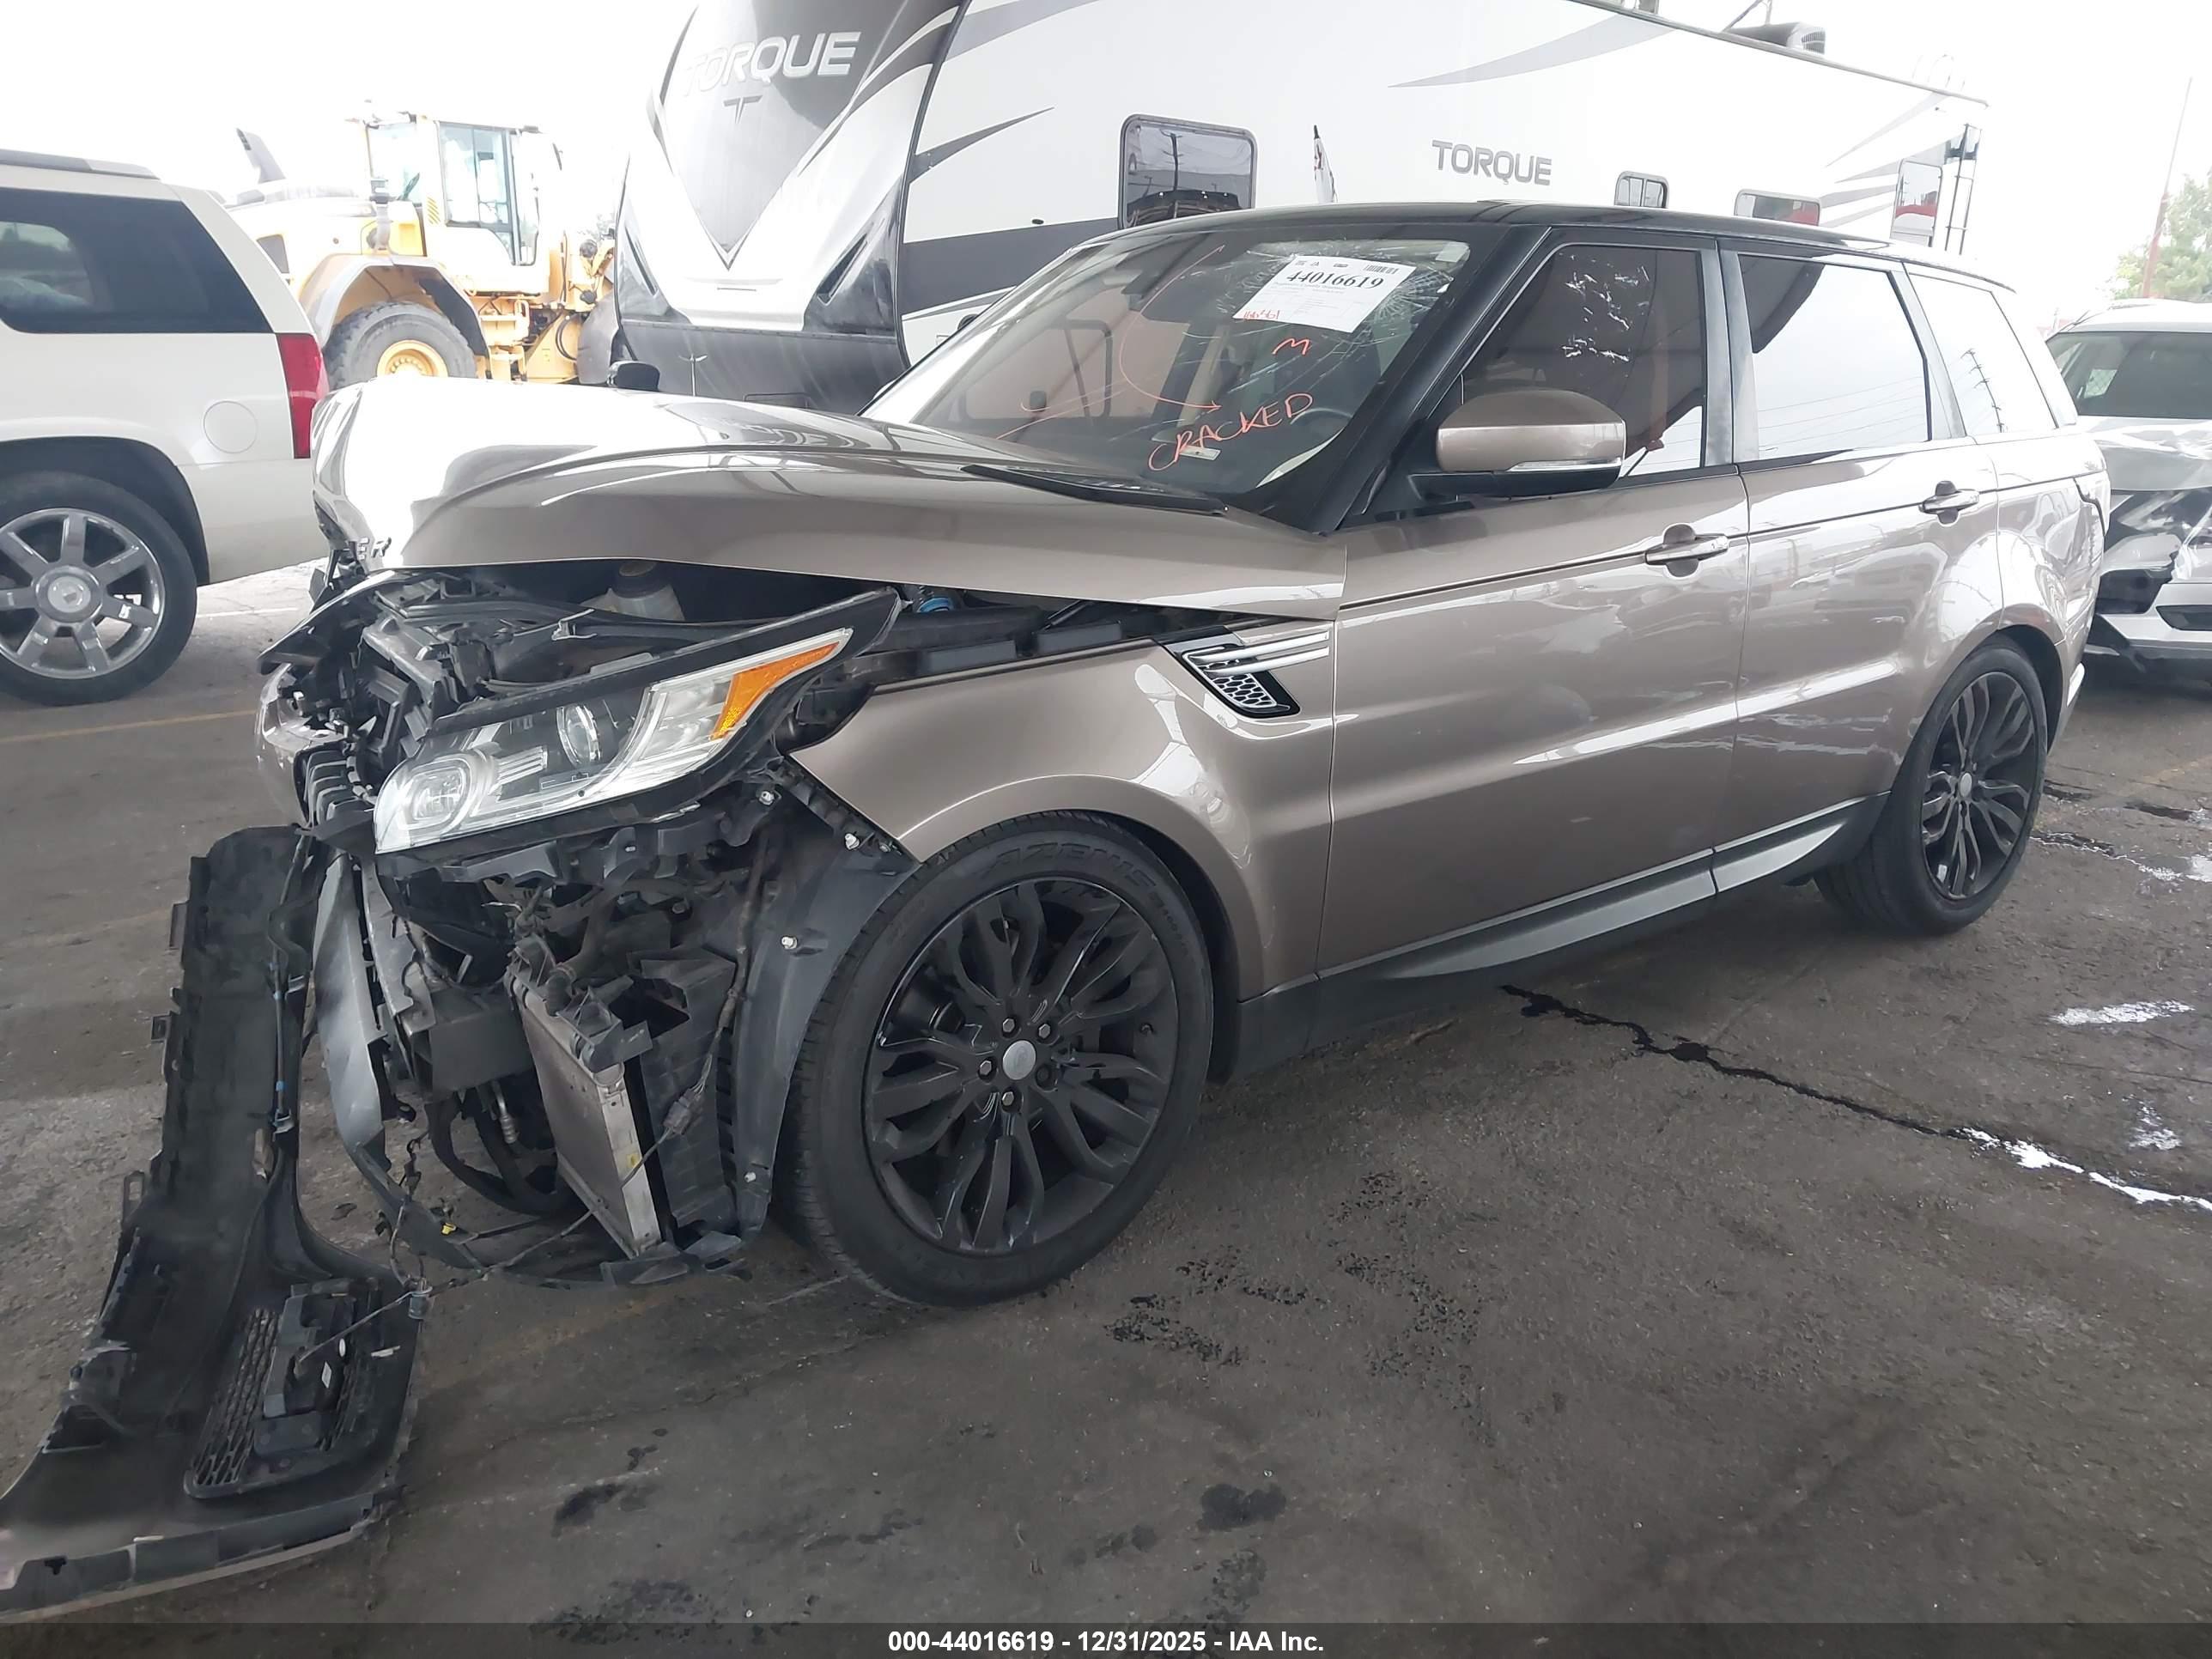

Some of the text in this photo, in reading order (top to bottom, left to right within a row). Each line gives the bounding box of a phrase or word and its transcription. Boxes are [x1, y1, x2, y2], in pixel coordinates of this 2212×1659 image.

[684, 31, 861, 96] TORQUE
[1431, 139, 1553, 185] TORQUE
[1285, 270, 1384, 290] 44016619
[1148, 393, 1313, 471] CRACKED
